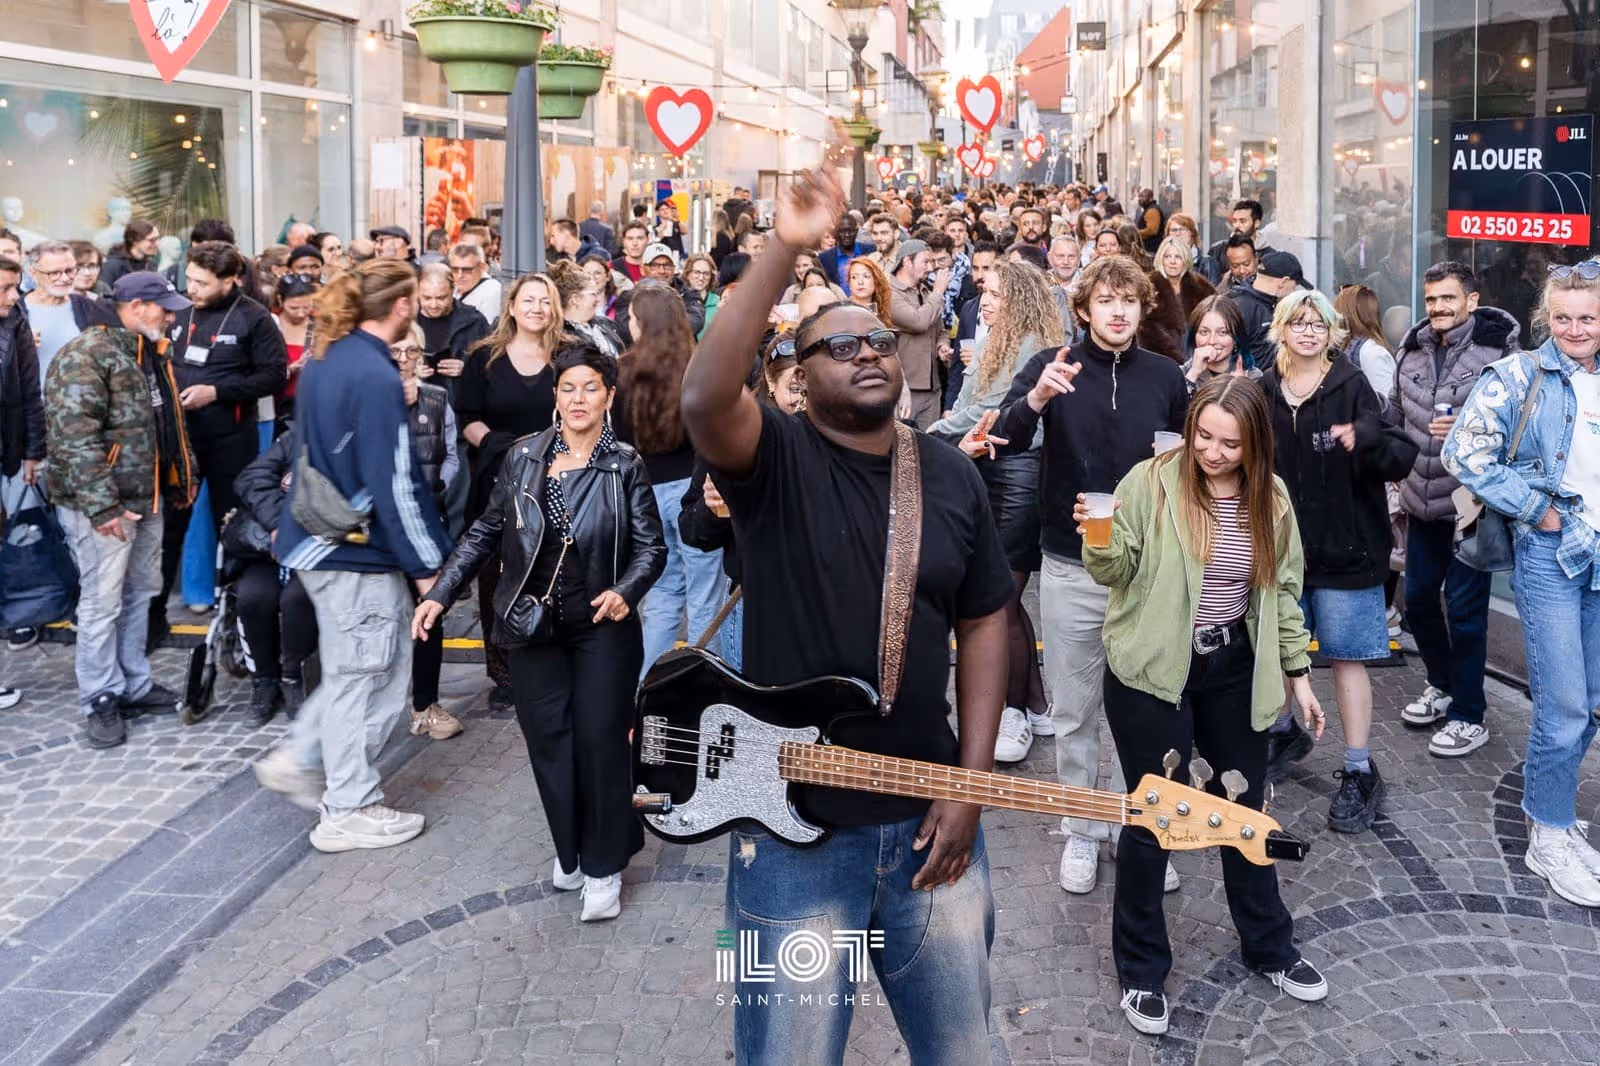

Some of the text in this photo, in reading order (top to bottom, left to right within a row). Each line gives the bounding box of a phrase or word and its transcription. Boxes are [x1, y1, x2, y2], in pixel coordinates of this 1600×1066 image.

[1568, 127, 1587, 140] JLL
[1452, 147, 1543, 171] A LOUER
[1460, 215, 1573, 239] 02 550 25 25
